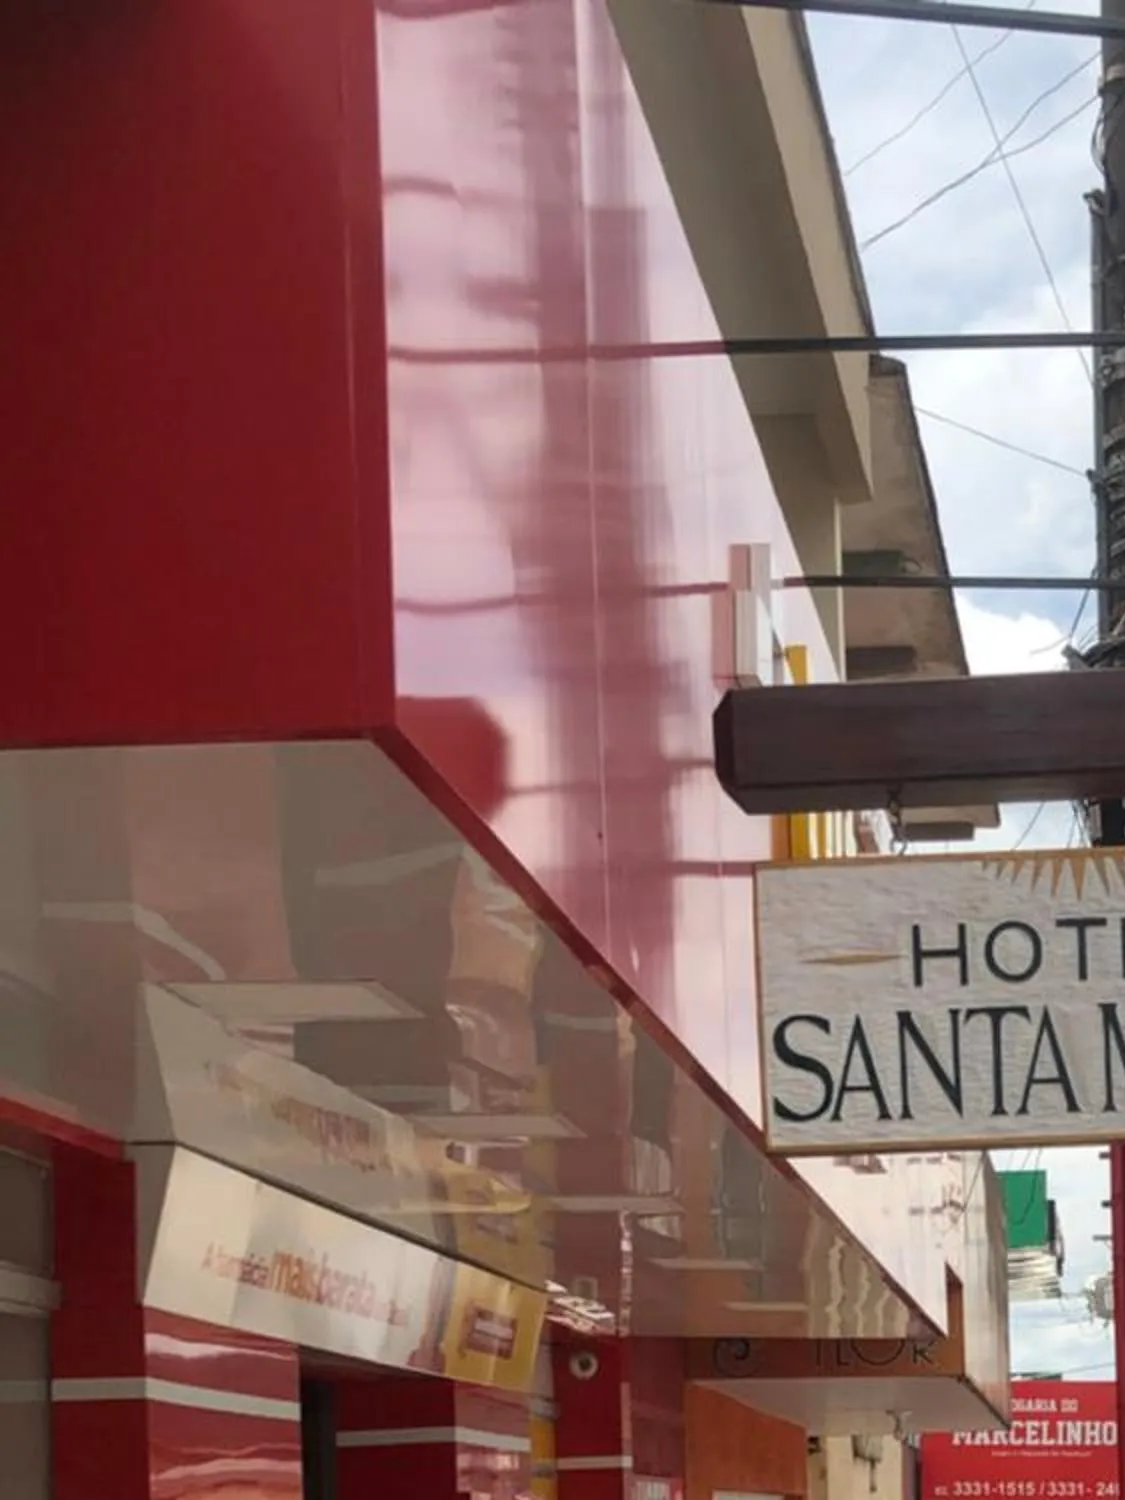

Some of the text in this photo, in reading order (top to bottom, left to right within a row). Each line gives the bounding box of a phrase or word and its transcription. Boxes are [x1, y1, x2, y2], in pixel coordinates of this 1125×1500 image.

[772, 1003, 1082, 1123] SANTA
[951, 1420, 1119, 1446] MARCELINHO
[952, 1480, 1036, 1497] 3331-1515
